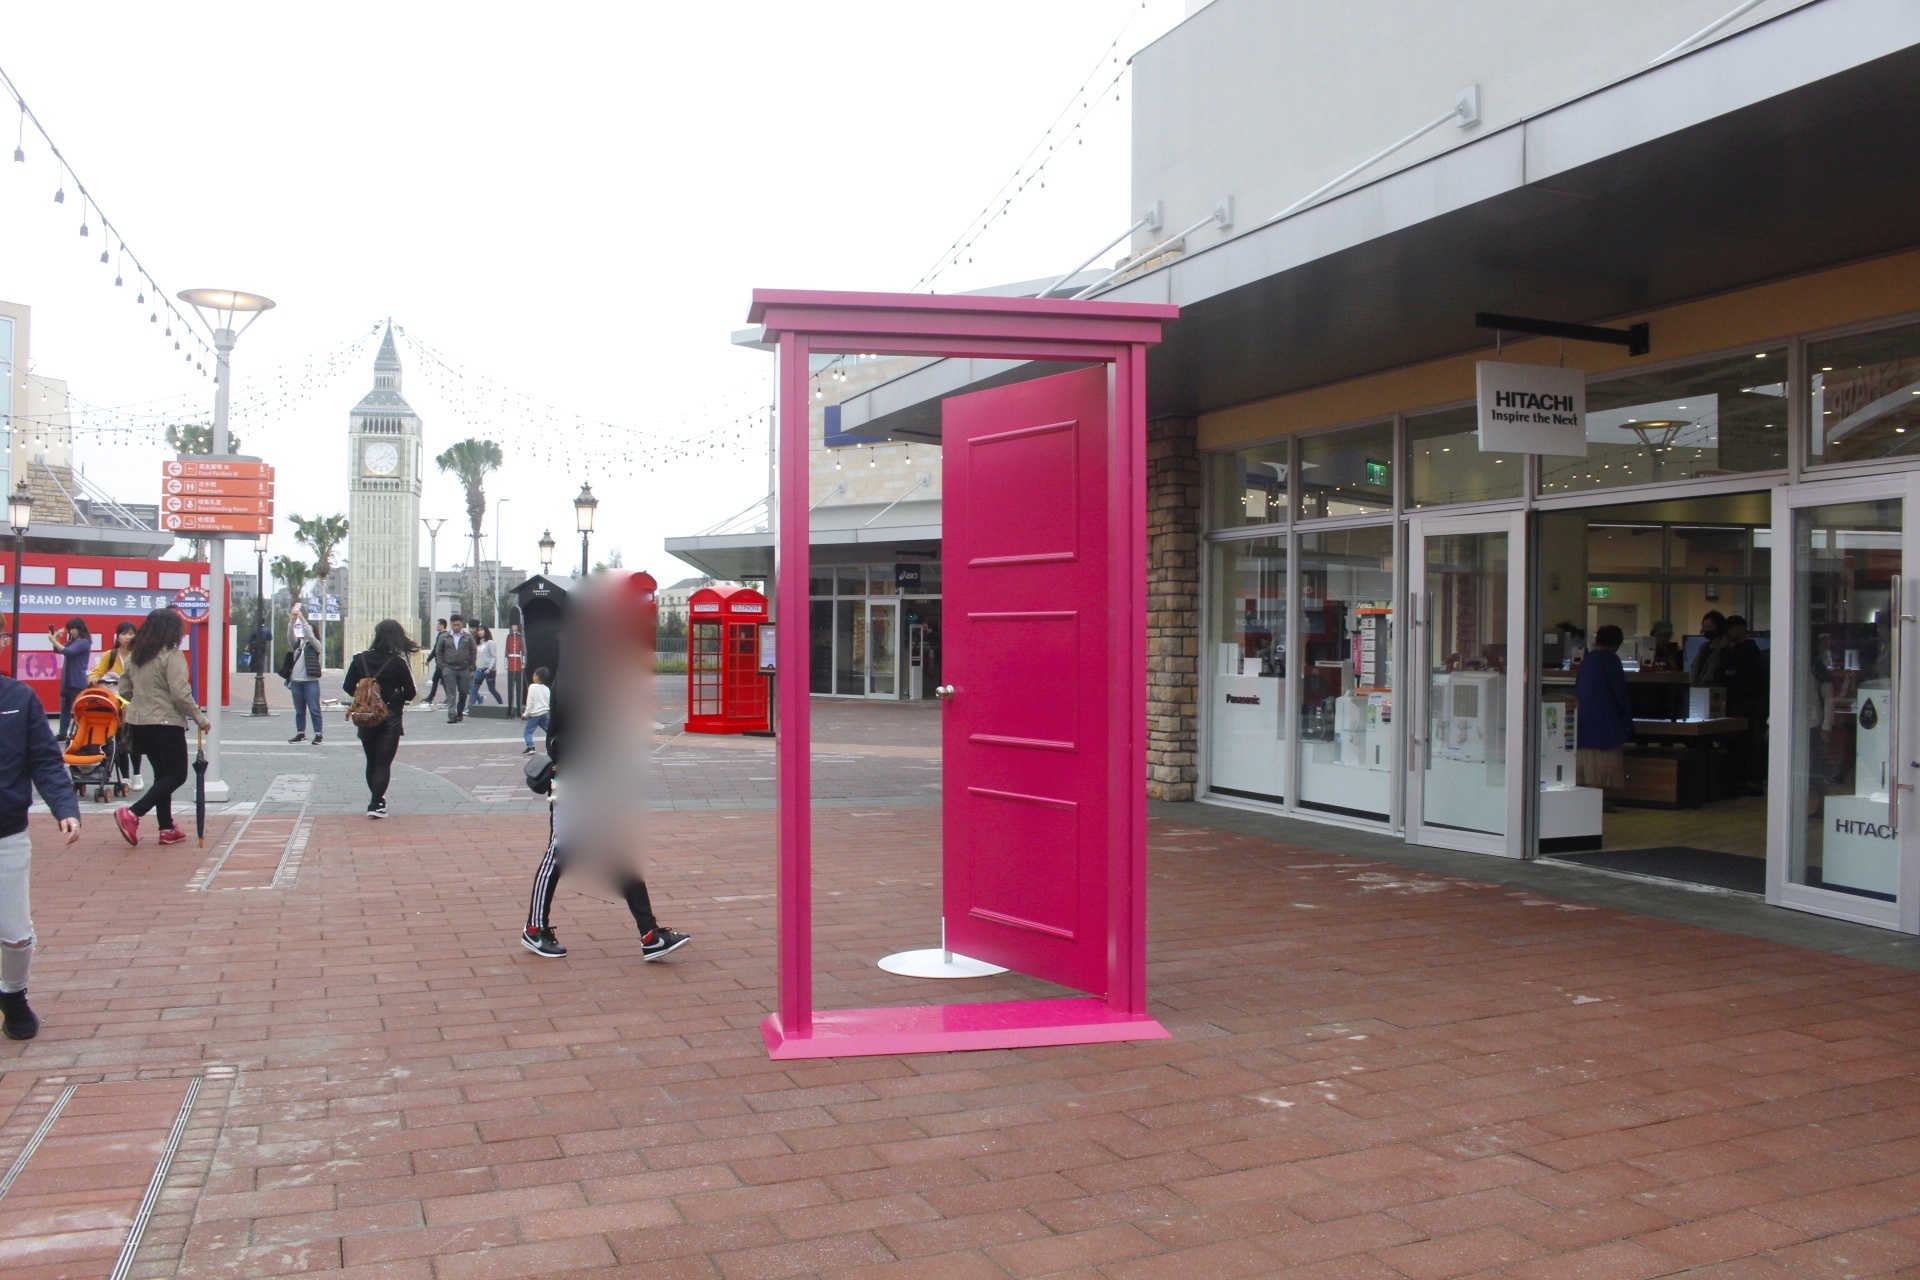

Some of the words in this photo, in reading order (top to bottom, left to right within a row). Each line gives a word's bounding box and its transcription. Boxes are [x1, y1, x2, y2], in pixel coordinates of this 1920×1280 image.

[1496, 391, 1573, 412] HITACHI
[1491, 409, 1530, 424] Inspire
[1533, 413, 1550, 424] the
[1552, 413, 1578, 426] Next
[20, 594, 62, 605] GRAND
[66, 595, 117, 607] OPENING
[125, 594, 167, 609] 全區盛
[1226, 694, 1260, 705] Panasonic
